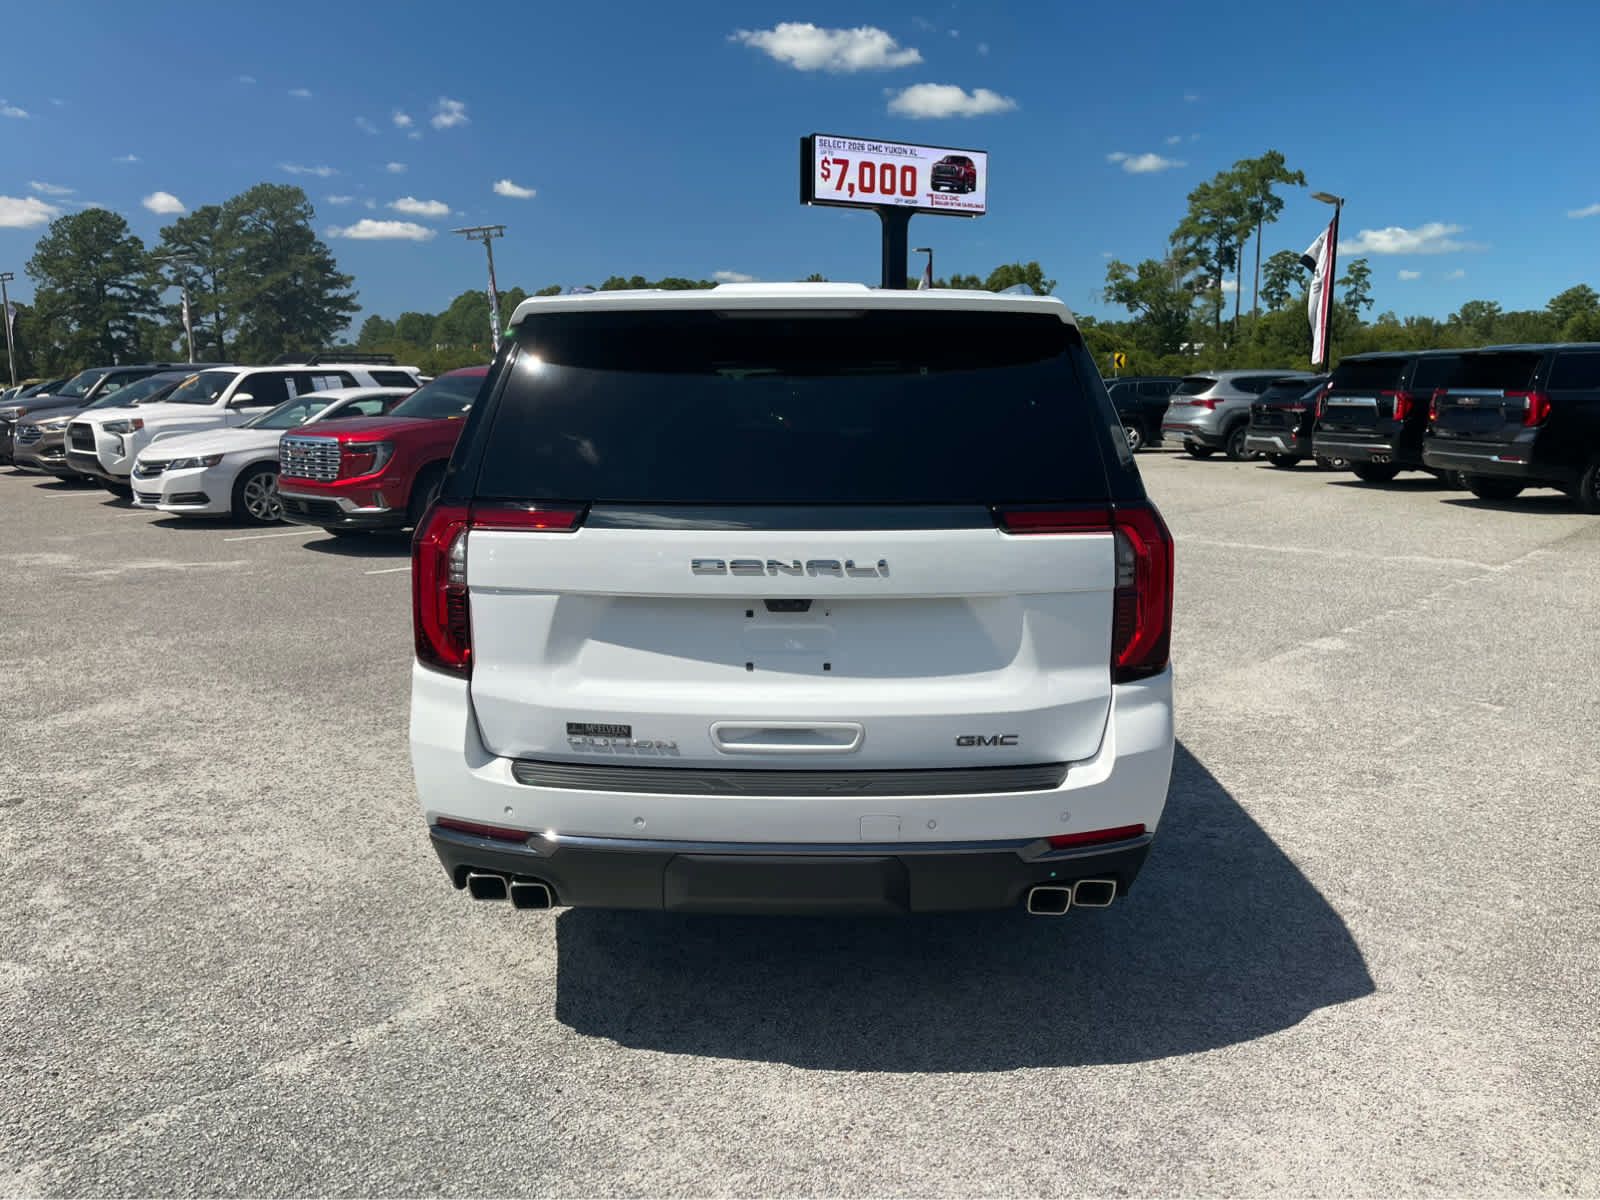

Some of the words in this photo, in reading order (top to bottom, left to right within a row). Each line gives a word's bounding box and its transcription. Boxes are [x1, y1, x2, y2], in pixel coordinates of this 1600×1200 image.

[819, 139, 846, 149] SELECT
[848, 142, 865, 151] 2026
[867, 144, 883, 152] GMC
[884, 146, 907, 155] YUKON
[909, 148, 918, 156] XL
[821, 155, 917, 197] $7,000
[691, 559, 889, 575] DENALI
[956, 735, 1019, 747] GMC
